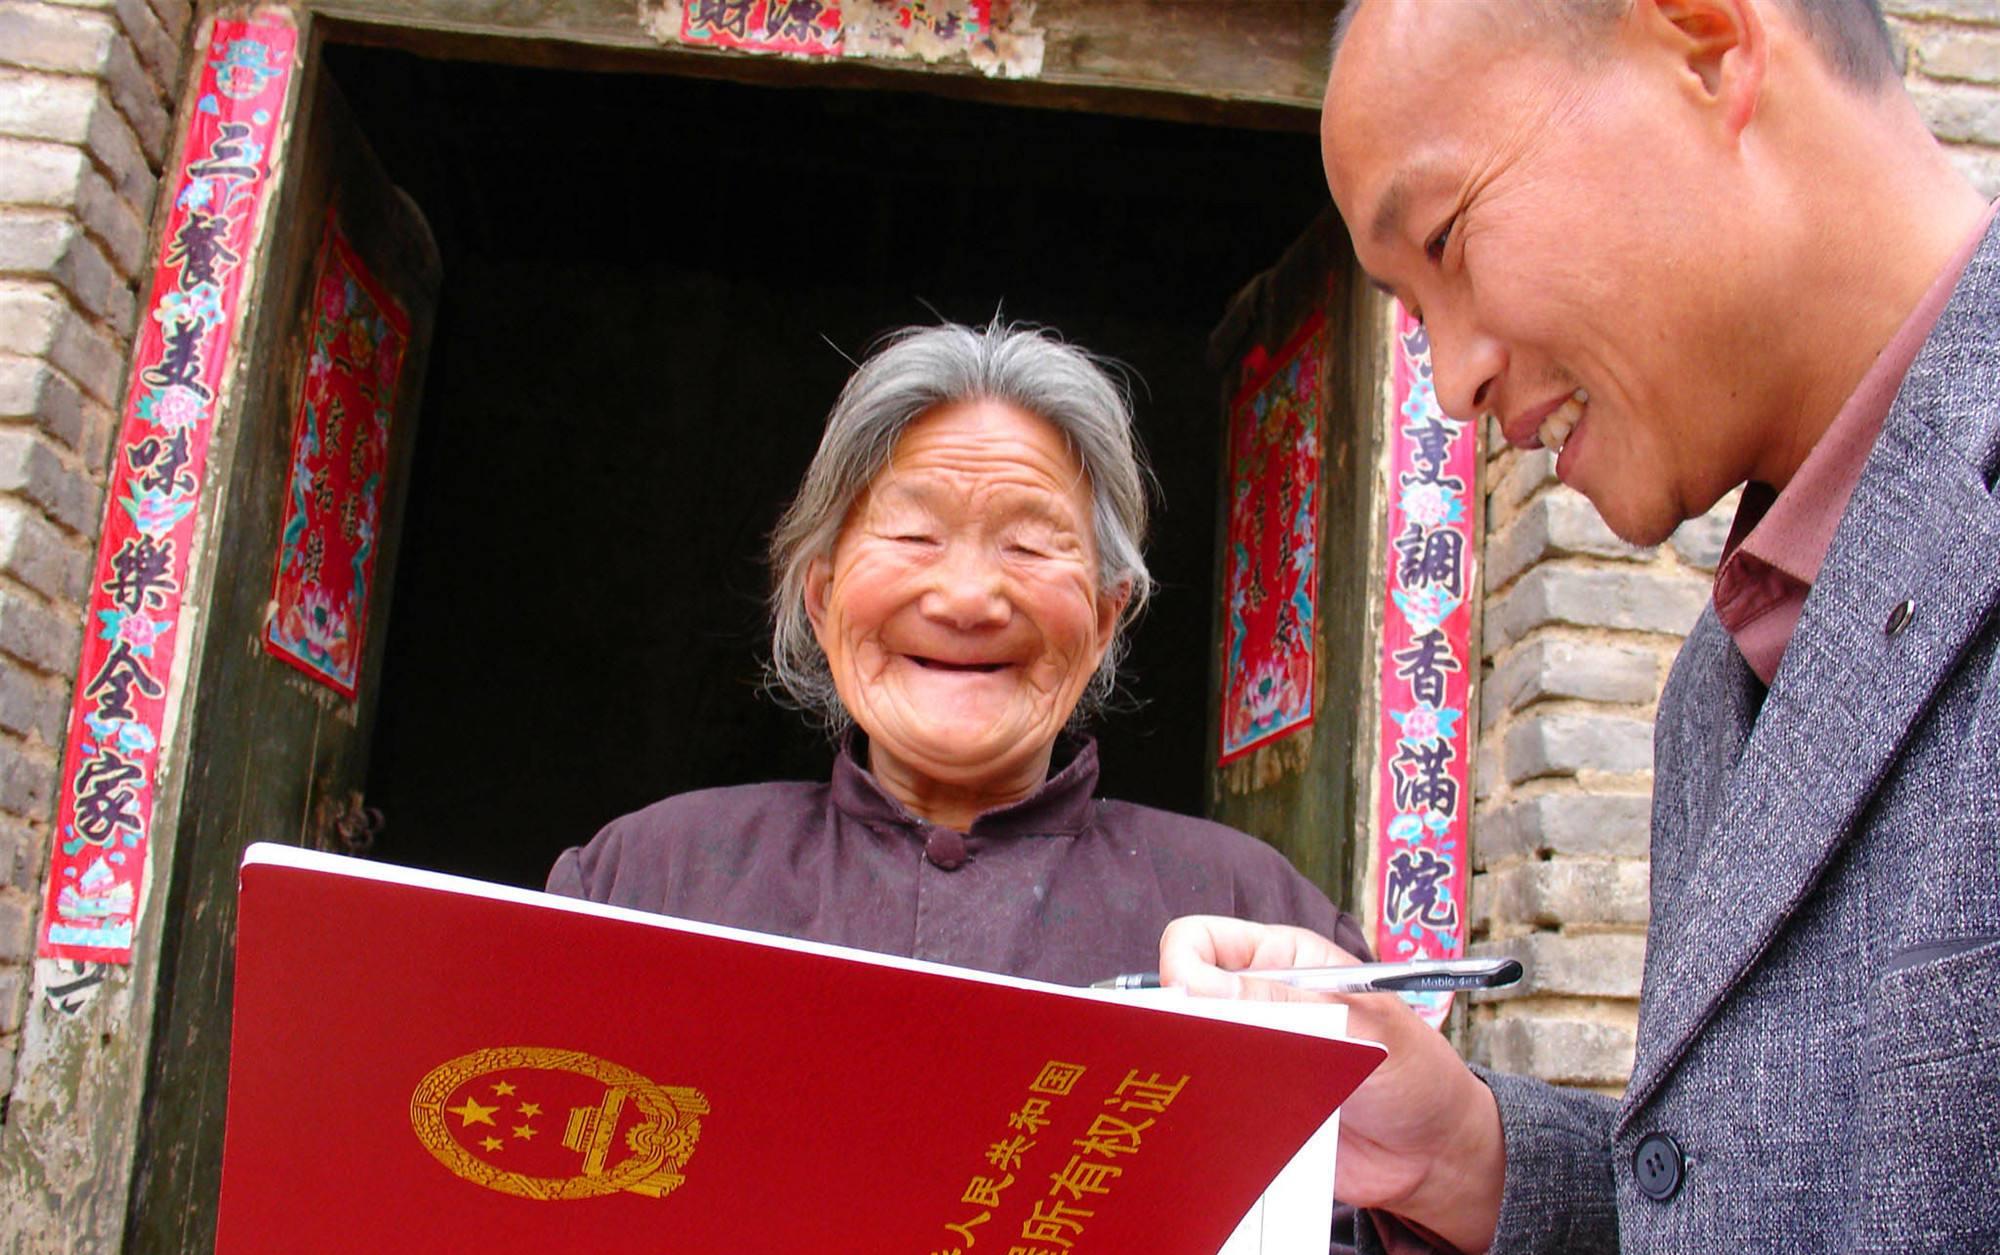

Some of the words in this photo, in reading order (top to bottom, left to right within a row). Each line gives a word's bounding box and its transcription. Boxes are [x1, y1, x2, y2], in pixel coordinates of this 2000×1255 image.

[75, 124, 262, 842] 三餐美味樂全家
[930, 1060, 1087, 1255] 人民共和国
